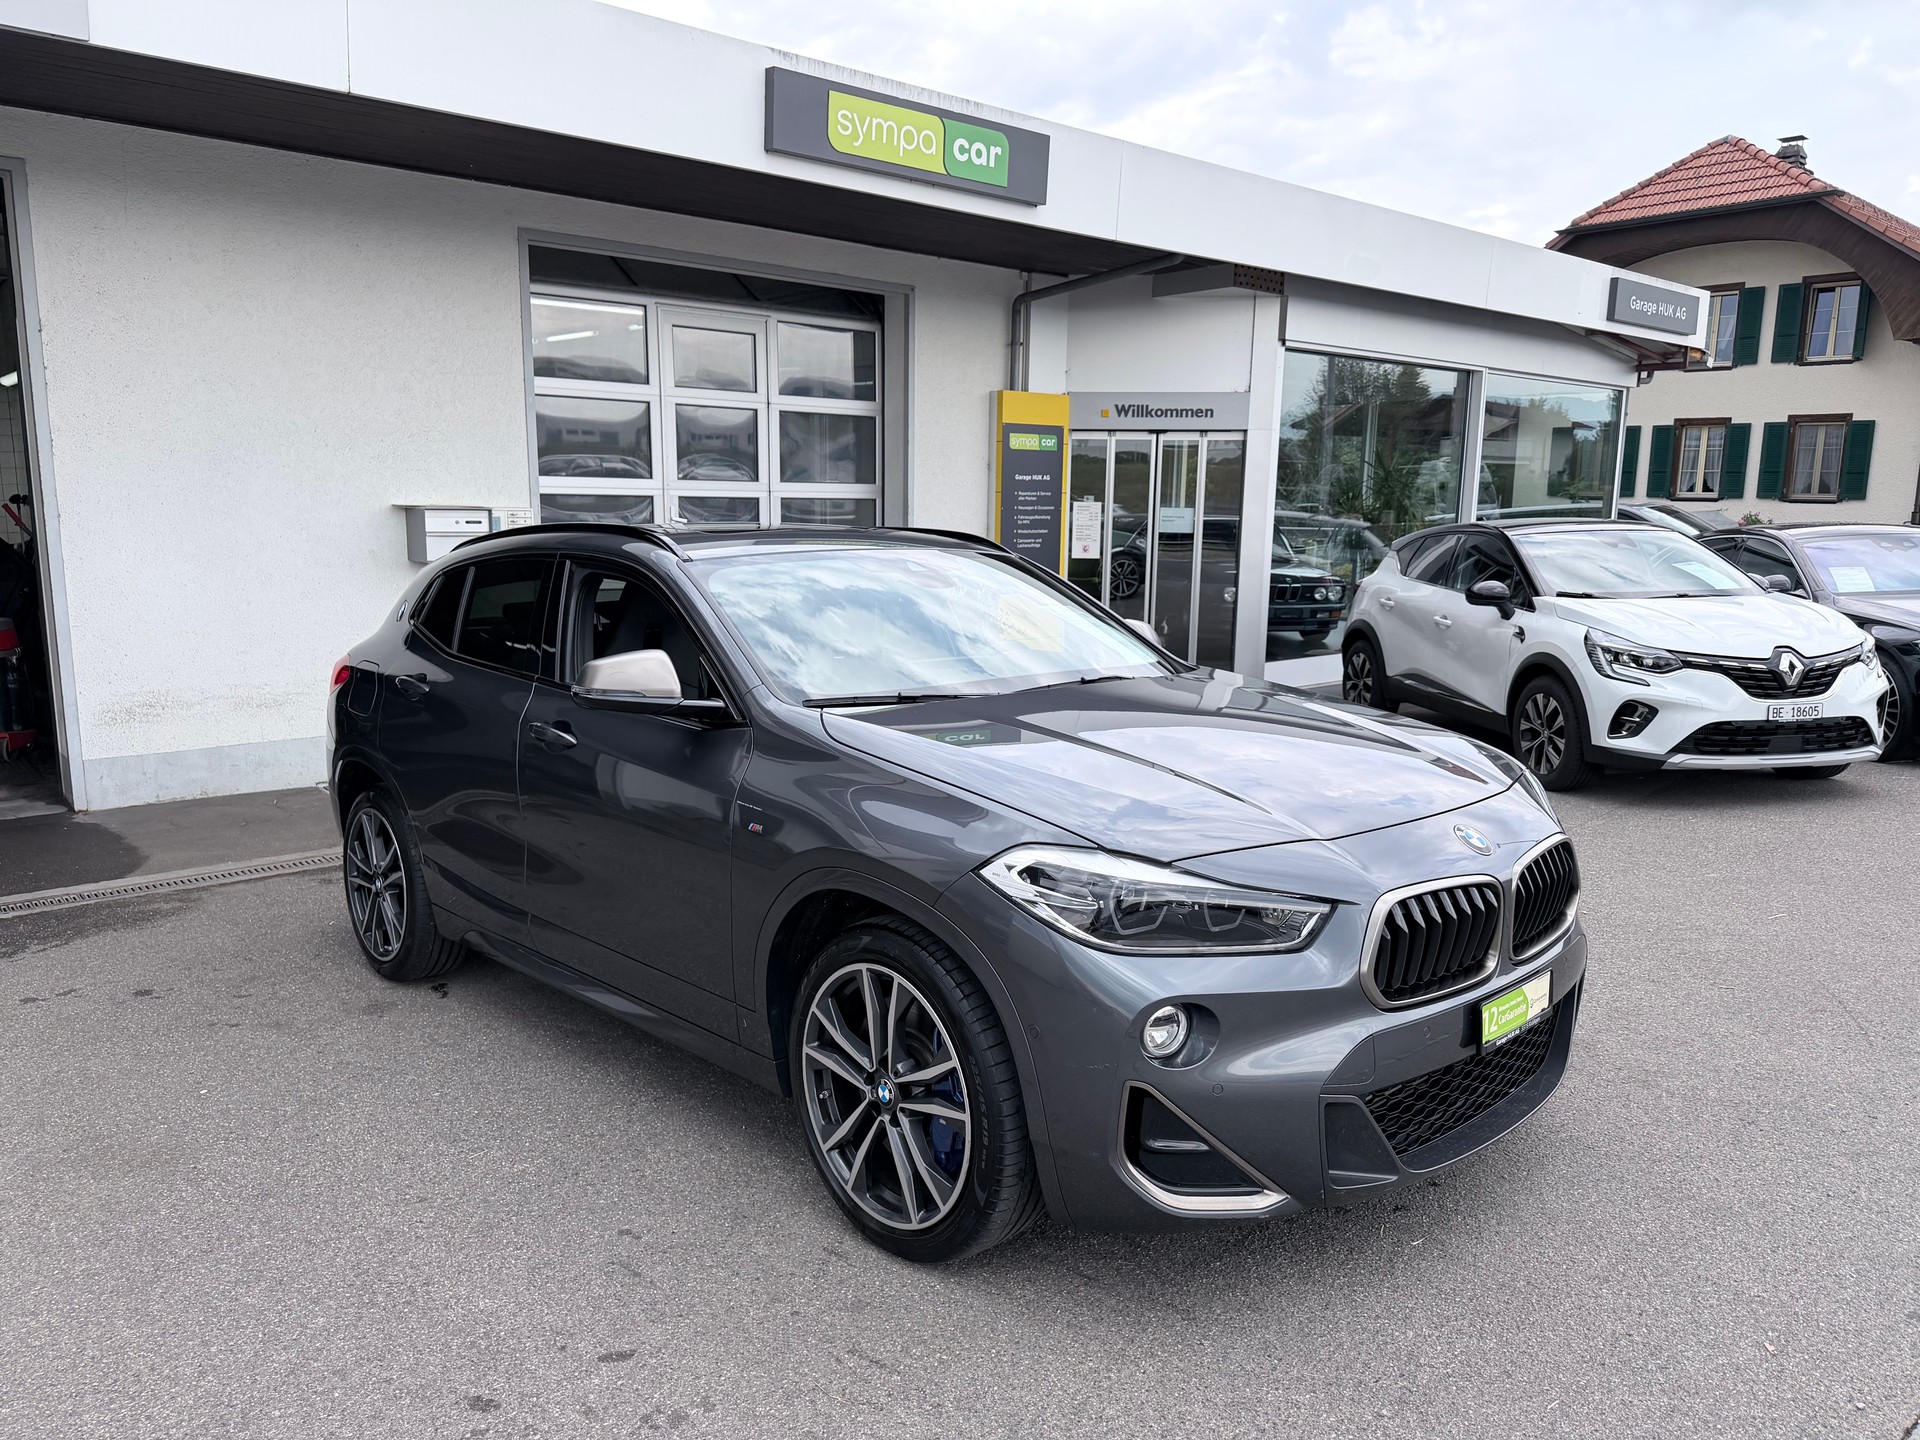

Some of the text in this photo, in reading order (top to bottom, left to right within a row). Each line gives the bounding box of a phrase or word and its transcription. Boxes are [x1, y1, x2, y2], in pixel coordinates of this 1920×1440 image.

[836, 108, 1002, 168] sympa car
[1630, 296, 1687, 320] Garage HUK AG
[1114, 404, 1215, 418] Willkommen
[1011, 437, 1056, 447] sympa car
[1772, 705, 1820, 719] BE 18605
[1482, 1006, 1498, 1037] 12
